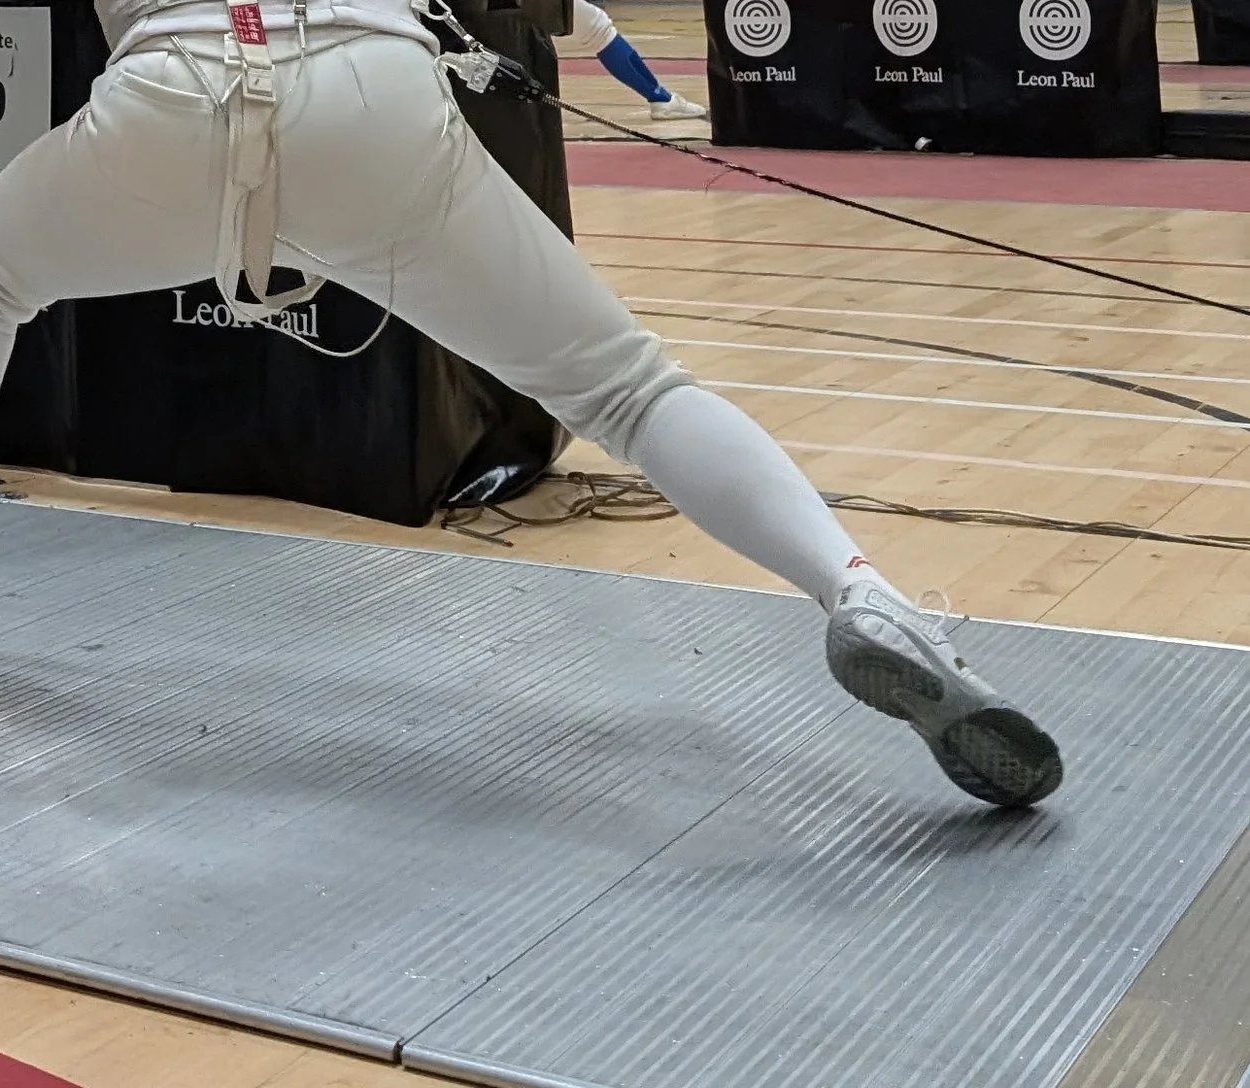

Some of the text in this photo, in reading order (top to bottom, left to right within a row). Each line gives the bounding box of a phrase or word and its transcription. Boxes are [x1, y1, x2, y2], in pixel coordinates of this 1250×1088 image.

[729, 66, 796, 82] Leon Paul
[875, 65, 943, 83] Leon Paul
[1017, 69, 1095, 88] Leon Paul
